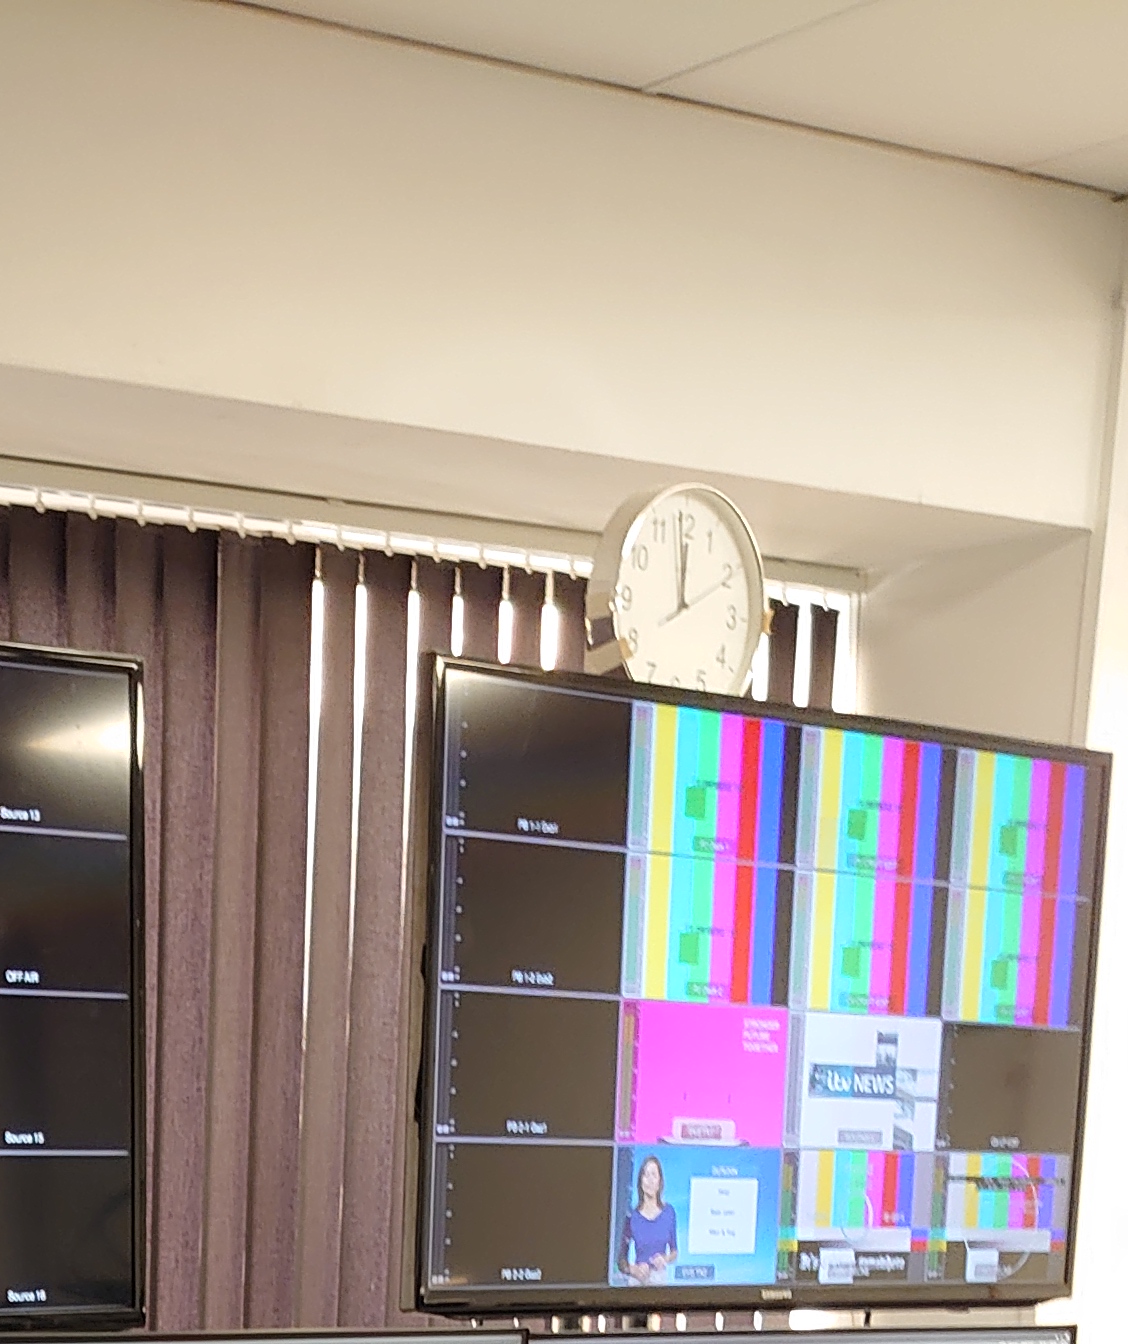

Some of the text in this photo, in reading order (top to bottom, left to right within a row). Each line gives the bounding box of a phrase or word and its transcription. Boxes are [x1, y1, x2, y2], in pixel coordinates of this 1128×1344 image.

[652, 517, 666, 543] 11
[631, 544, 648, 571] 10
[726, 605, 737, 630] 3
[826, 1071, 894, 1095] itv NEWS
